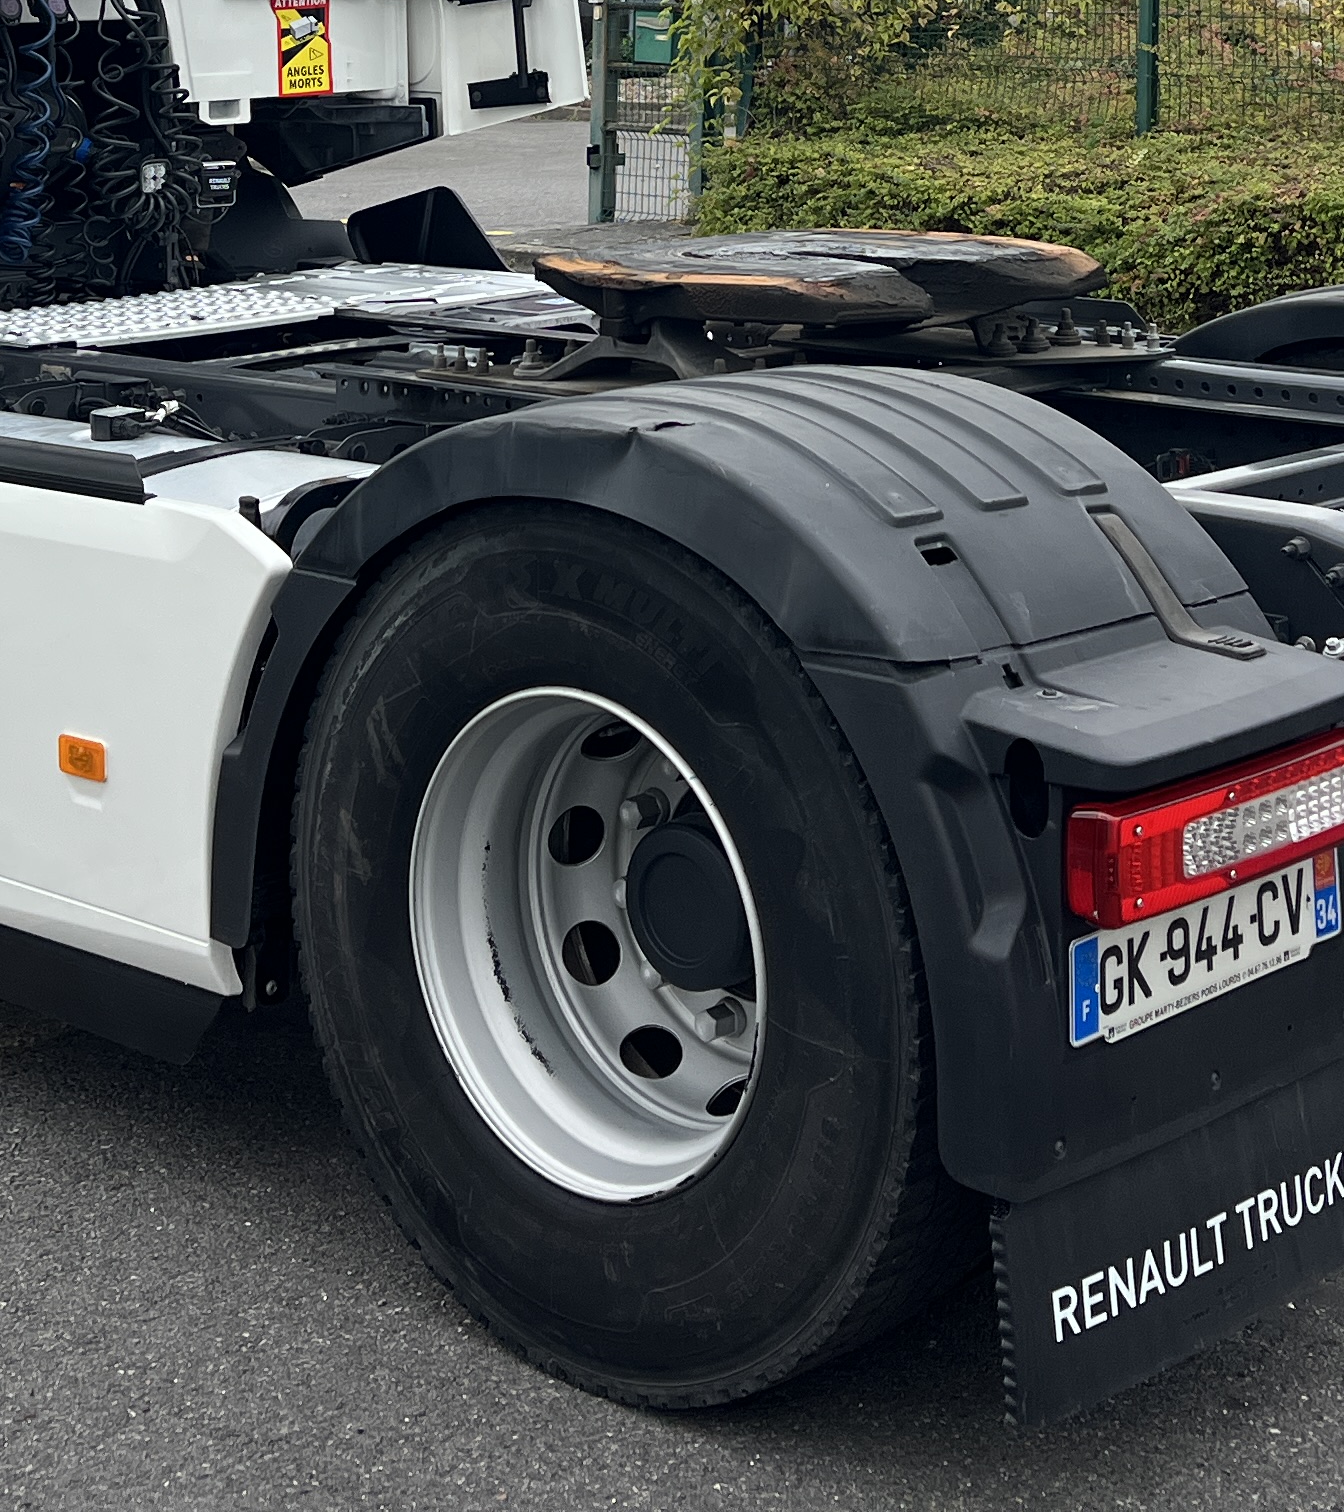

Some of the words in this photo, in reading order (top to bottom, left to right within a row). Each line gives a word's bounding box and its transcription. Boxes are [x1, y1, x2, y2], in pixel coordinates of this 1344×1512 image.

[286, 64, 325, 77] ANGLES
[289, 76, 323, 89] MORTS
[1316, 893, 1337, 930] 34
[1099, 867, 1304, 1016] GK-944-CV
[1082, 999, 1091, 1023] F
[1051, 1211, 1228, 1343] RENAULT
